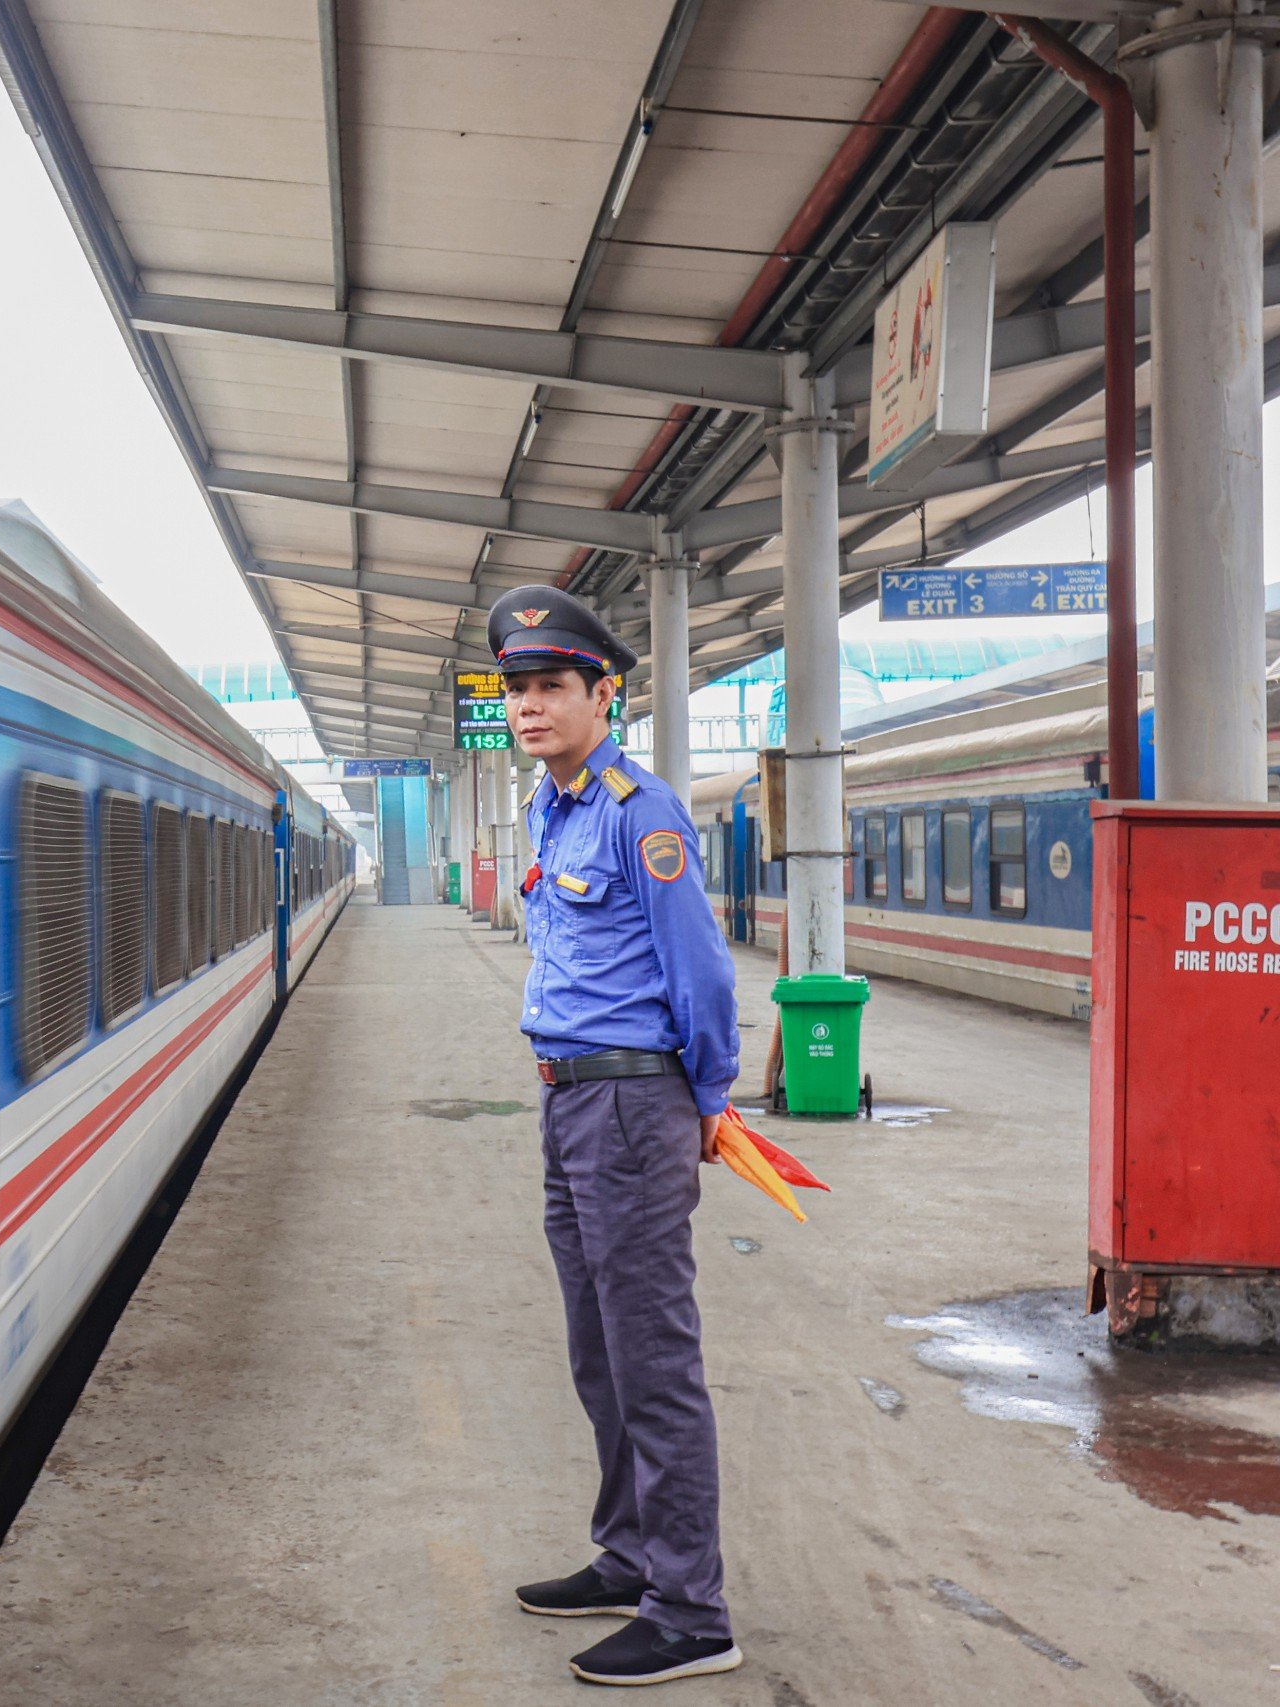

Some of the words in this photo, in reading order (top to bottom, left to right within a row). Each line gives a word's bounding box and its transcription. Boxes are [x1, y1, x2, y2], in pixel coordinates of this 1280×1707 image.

[1091, 568, 1100, 576] RA
[907, 598, 957, 615] EXIT
[969, 594, 985, 613] 3
[1031, 592, 1047, 610] 4
[1057, 592, 1107, 610] EXIT
[473, 705, 506, 720] LP6
[1175, 949, 1210, 972] FIRE
[1215, 951, 1259, 973] HOSE
